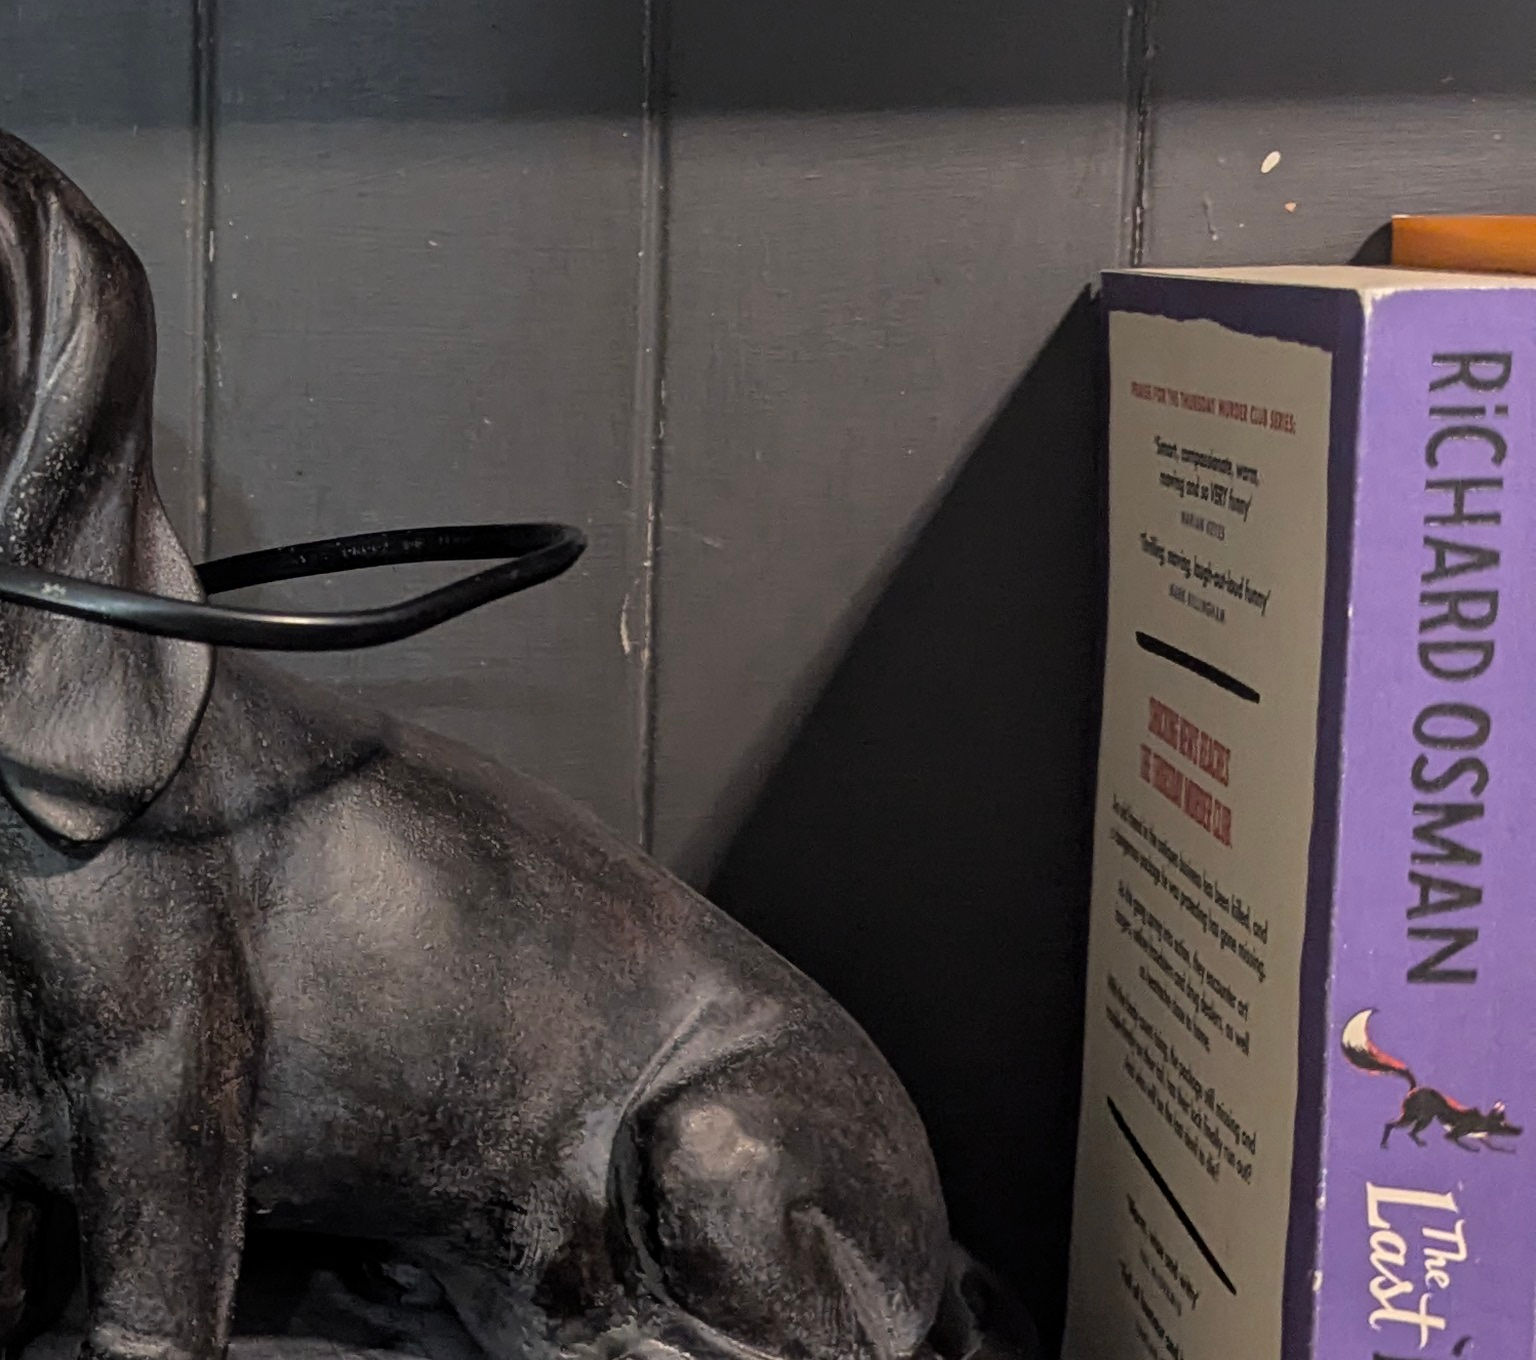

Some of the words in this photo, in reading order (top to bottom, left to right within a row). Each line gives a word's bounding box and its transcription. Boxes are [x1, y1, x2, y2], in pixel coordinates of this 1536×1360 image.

[1405, 701, 1492, 986] OSMAN
[1366, 1181, 1460, 1350] Last
[1422, 1219, 1468, 1291] The
